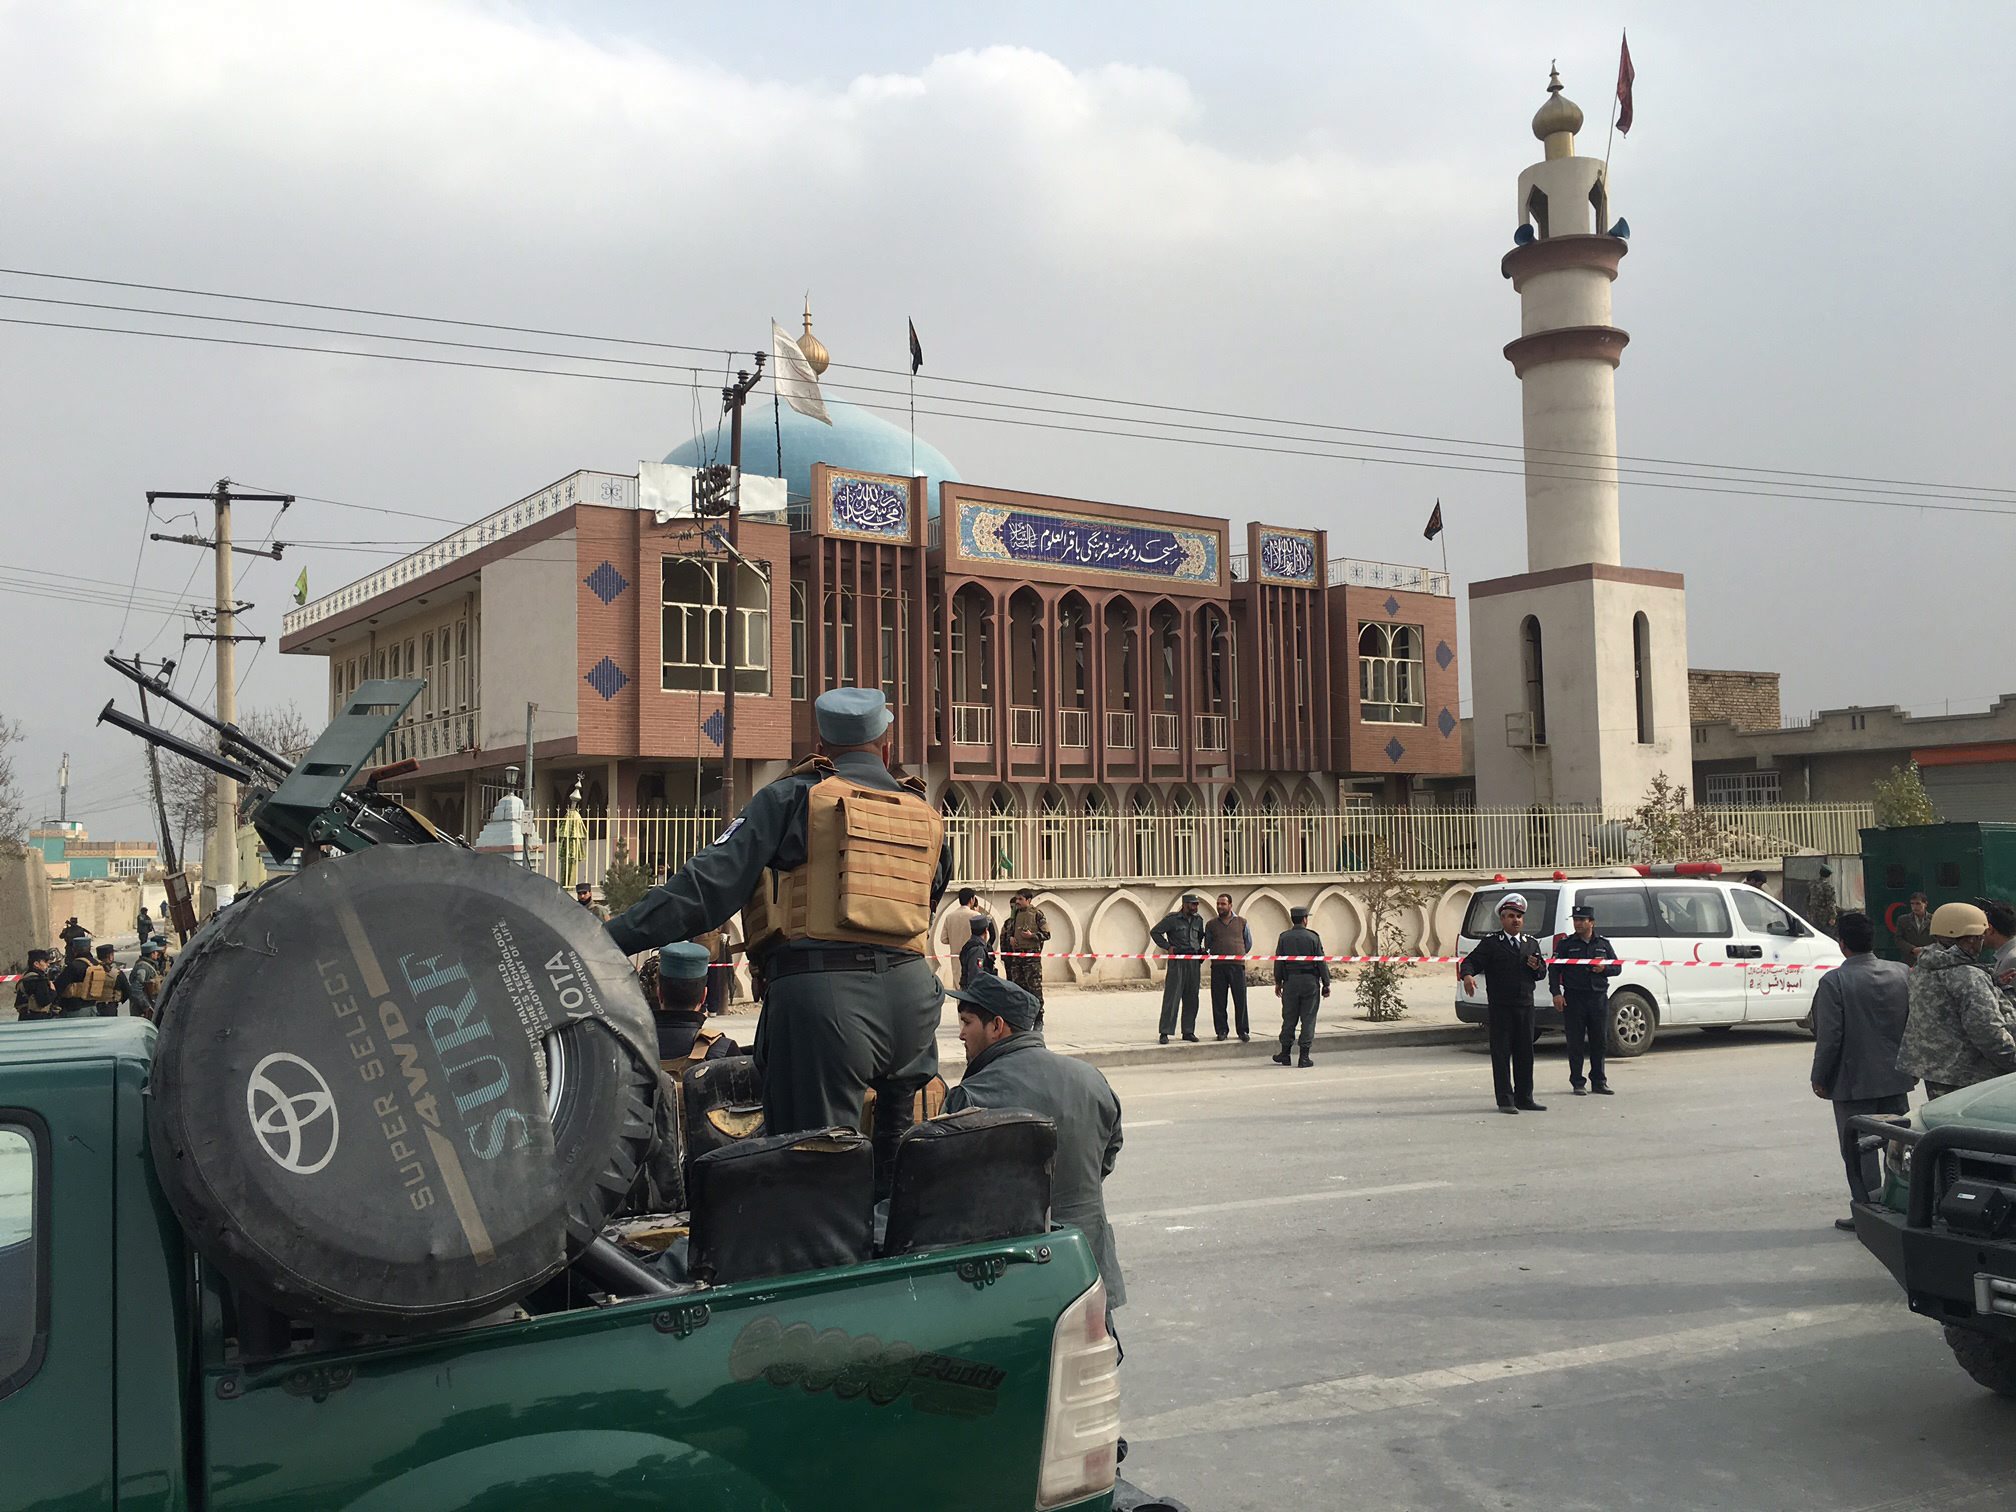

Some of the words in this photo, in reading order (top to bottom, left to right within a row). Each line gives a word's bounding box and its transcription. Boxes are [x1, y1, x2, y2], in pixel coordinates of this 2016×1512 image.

[1135, 540, 1178, 566] مسجد
[508, 944, 520, 957] OF
[511, 995, 529, 1025] RALLY
[516, 960, 549, 1022] ENJOYMENT
[544, 950, 593, 1024] YOTA
[315, 958, 385, 1082] SELECT
[521, 994, 545, 1040] UTURE'S
[525, 1026, 537, 1049] THE
[379, 1001, 441, 1128] 4WD
[396, 951, 533, 1161] SURF
[533, 1051, 543, 1068] ON
[373, 1091, 435, 1211] SUPER
